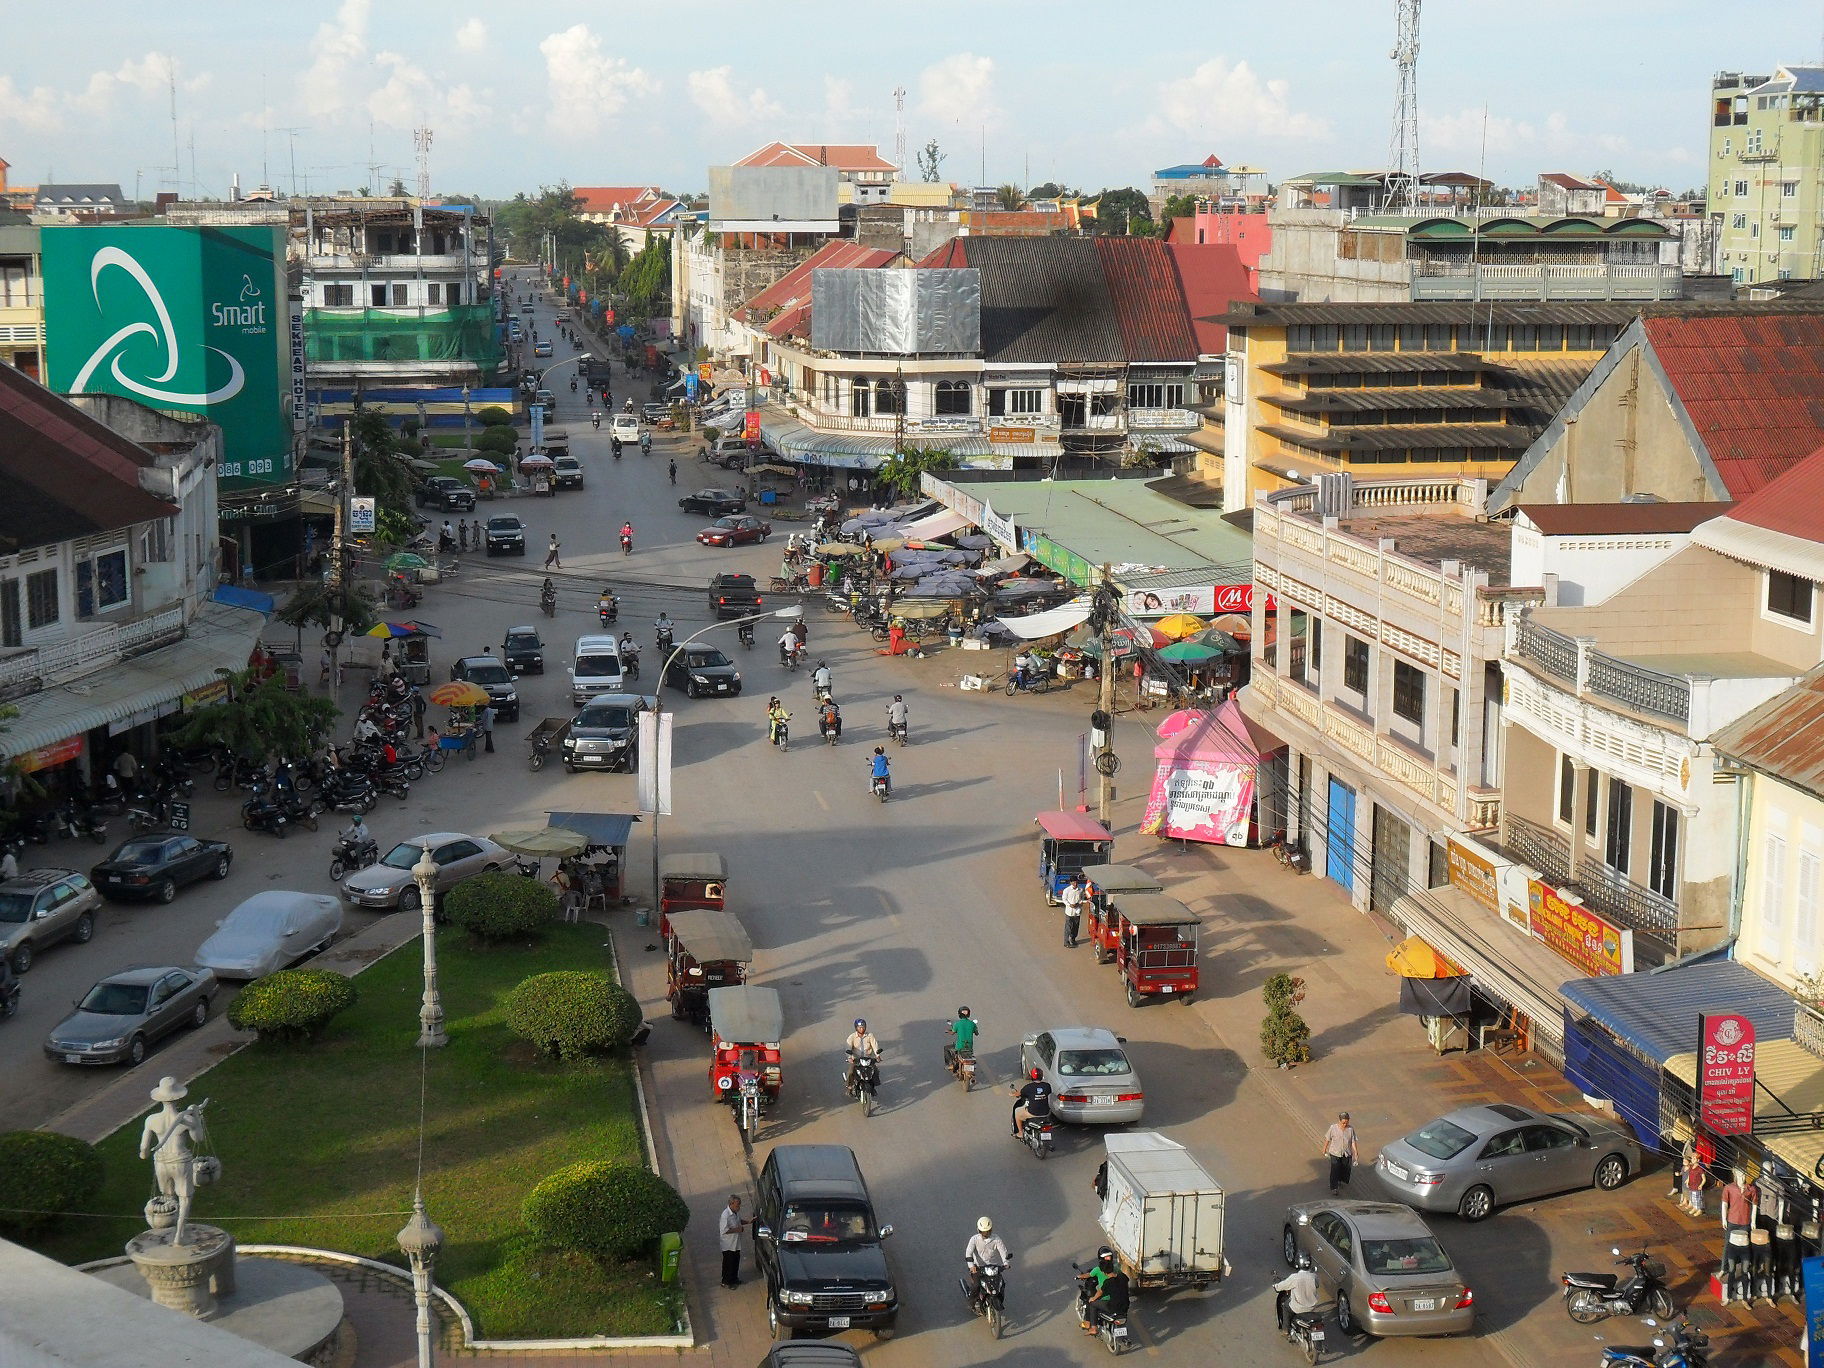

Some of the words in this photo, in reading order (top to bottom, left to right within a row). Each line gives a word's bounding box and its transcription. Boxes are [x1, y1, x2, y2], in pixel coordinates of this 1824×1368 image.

[212, 301, 265, 326] Smart
[242, 326, 267, 334] mobile
[291, 314, 303, 373] SEKMEAS
[293, 379, 304, 420] HOTEL
[217, 463, 241, 477] 086
[249, 459, 272, 473] 093
[1202, 780, 1215, 790] qb
[1708, 1068, 1732, 1077] CHIV
[1737, 1066, 1750, 1075] LY
